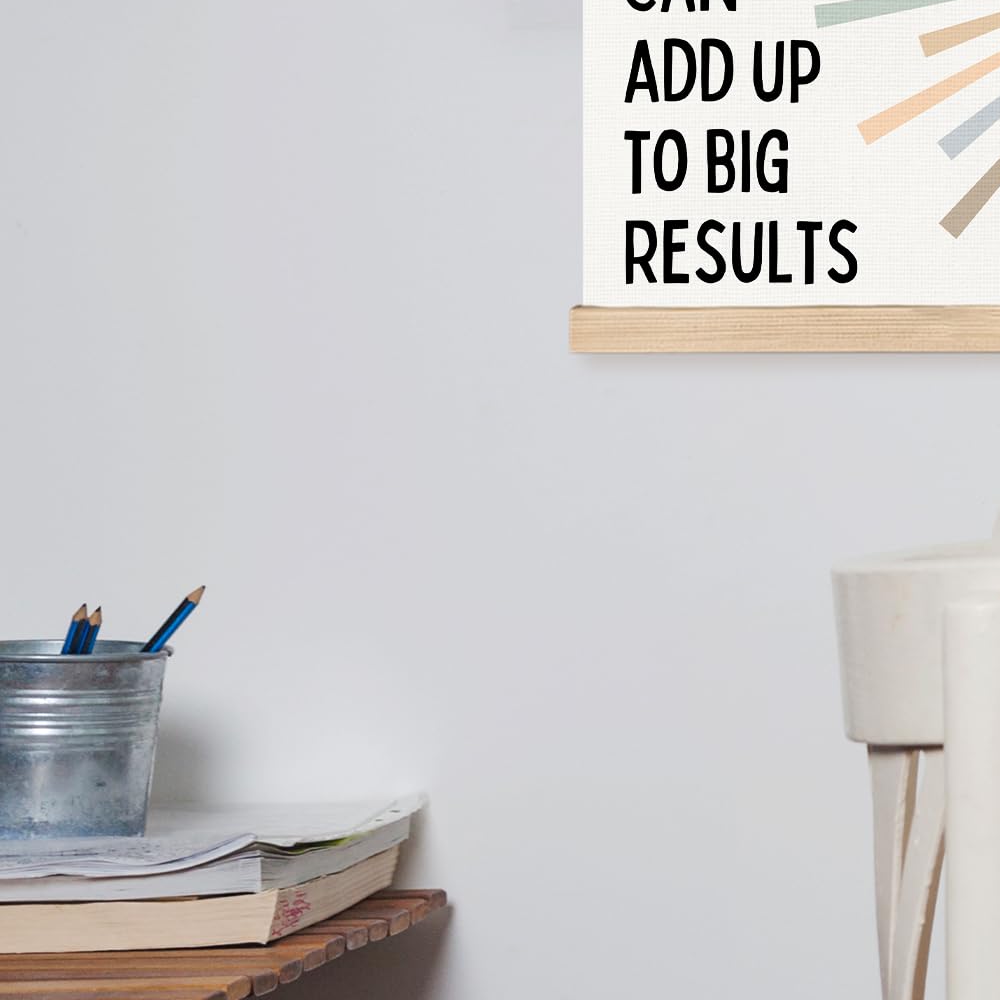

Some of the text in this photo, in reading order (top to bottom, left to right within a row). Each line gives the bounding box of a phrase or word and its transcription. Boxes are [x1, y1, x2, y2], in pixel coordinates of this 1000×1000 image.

[624, 38, 821, 103] ADD UP
[624, 128, 789, 194] TO BIG
[625, 219, 858, 284] RESULTS
